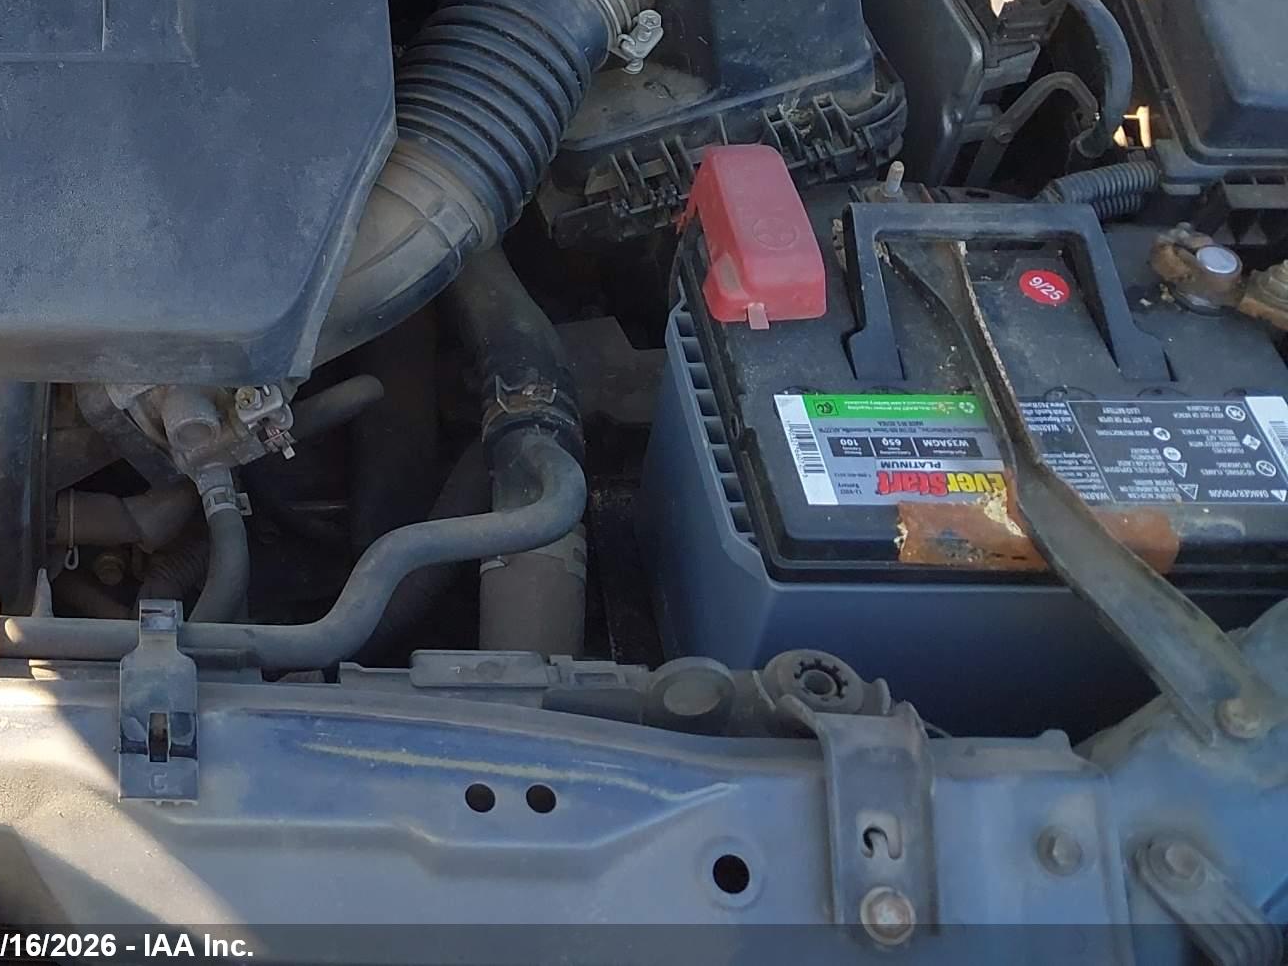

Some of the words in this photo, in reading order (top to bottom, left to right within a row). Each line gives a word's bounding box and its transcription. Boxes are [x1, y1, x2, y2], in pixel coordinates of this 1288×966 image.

[1028, 276, 1065, 300] 9/25
[840, 438, 858, 446] 100
[882, 438, 902, 446] 650
[922, 438, 969, 446] W35AGM
[880, 461, 942, 470] PLATINUM
[876, 471, 1009, 497] EverStart
